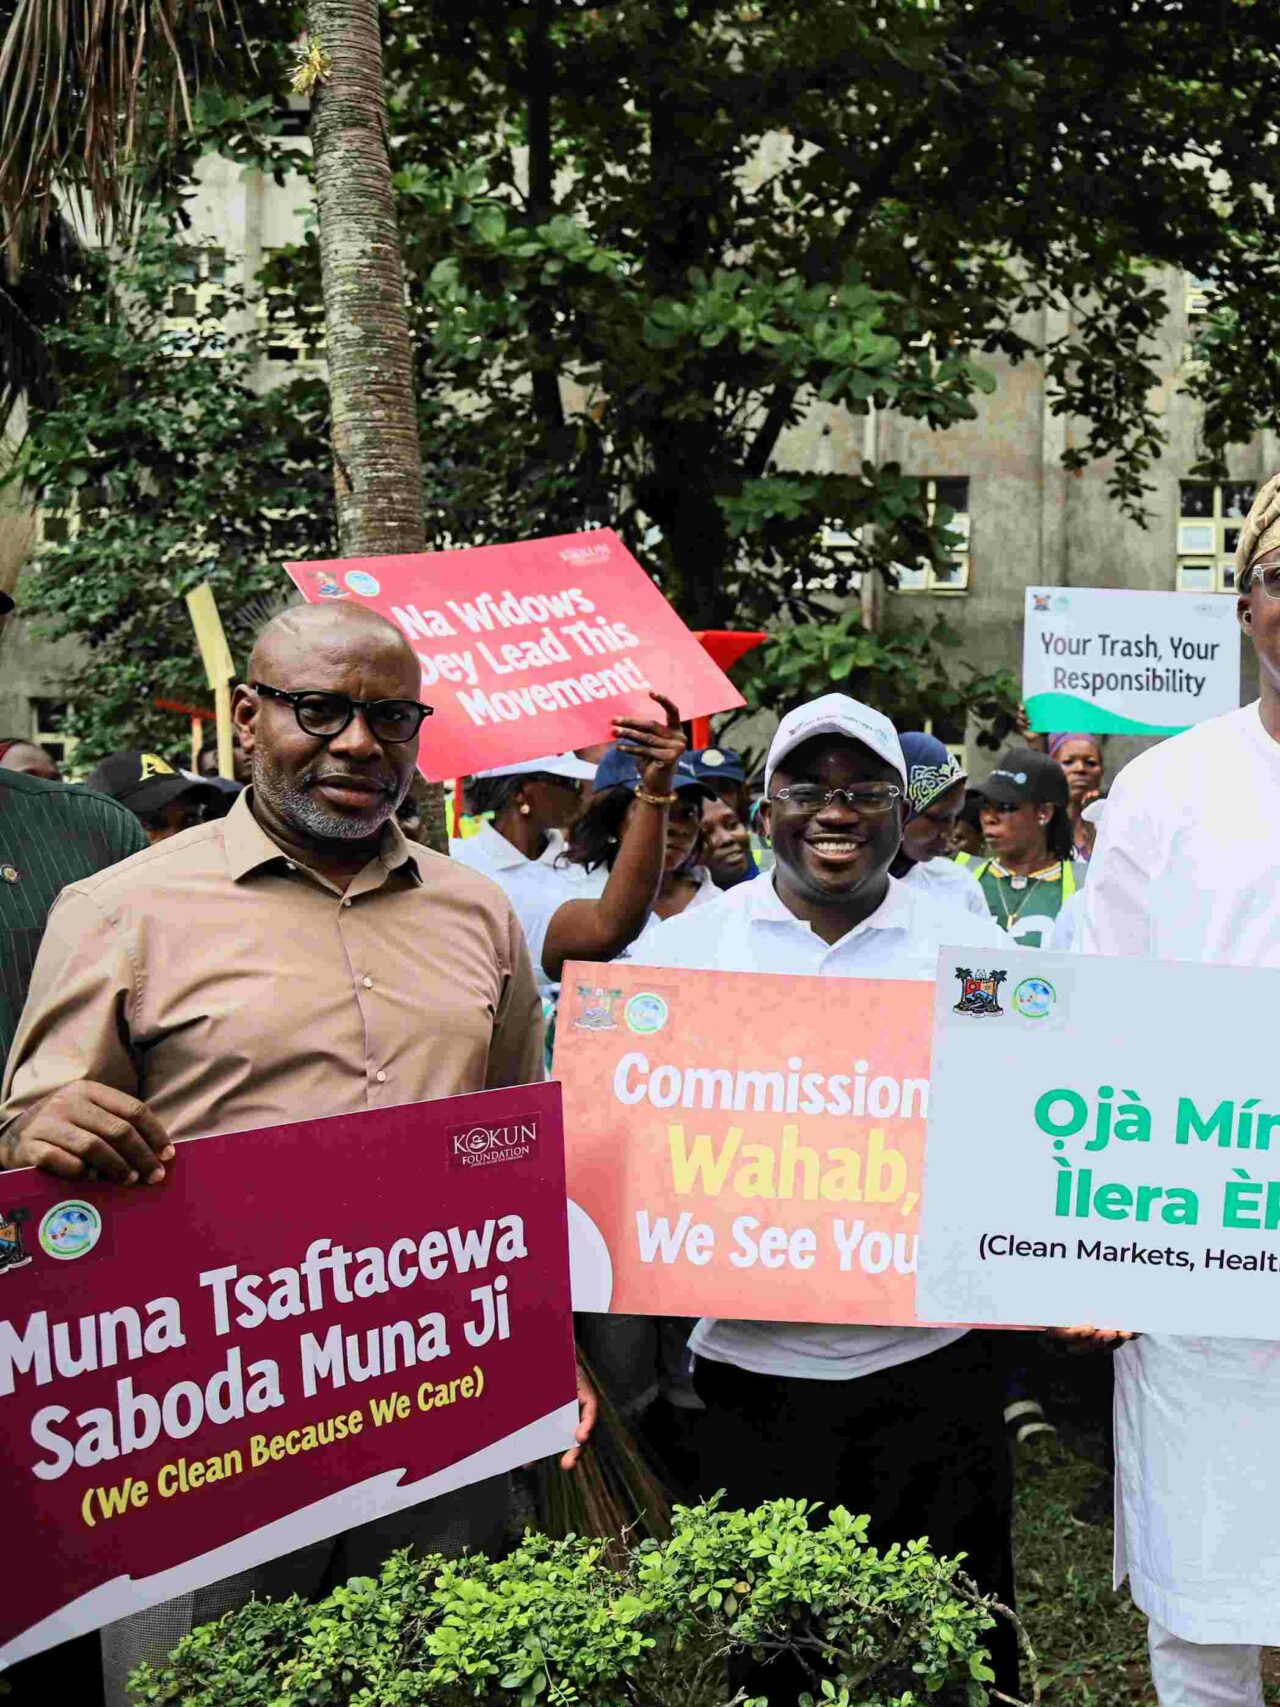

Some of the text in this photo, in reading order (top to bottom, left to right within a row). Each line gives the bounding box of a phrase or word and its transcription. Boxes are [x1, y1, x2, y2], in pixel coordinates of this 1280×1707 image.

[391, 588, 596, 640] Na Widows
[1041, 632, 1220, 662] Your Trash, Your
[417, 616, 640, 686] Dey Lead This
[1054, 667, 1206, 696] Responsibility
[456, 657, 652, 726] Movement!
[613, 1051, 932, 1119] Commission
[1033, 1085, 1152, 1152] Ọjà
[453, 1122, 536, 1155] KOKUN
[462, 1145, 530, 1165] FOUNDATION
[668, 1123, 920, 1215] Wahab,
[1053, 1156, 1199, 1226] Ìlera
[635, 1210, 919, 1274] We See You
[979, 1233, 1067, 1262] (Clean
[1077, 1240, 1196, 1272] Markets,
[0, 1214, 527, 1397] Muna Tsaftacewa
[30, 1275, 510, 1481] Saboda Muna Ji
[80, 1366, 485, 1527] (We Clean Because We Care)
